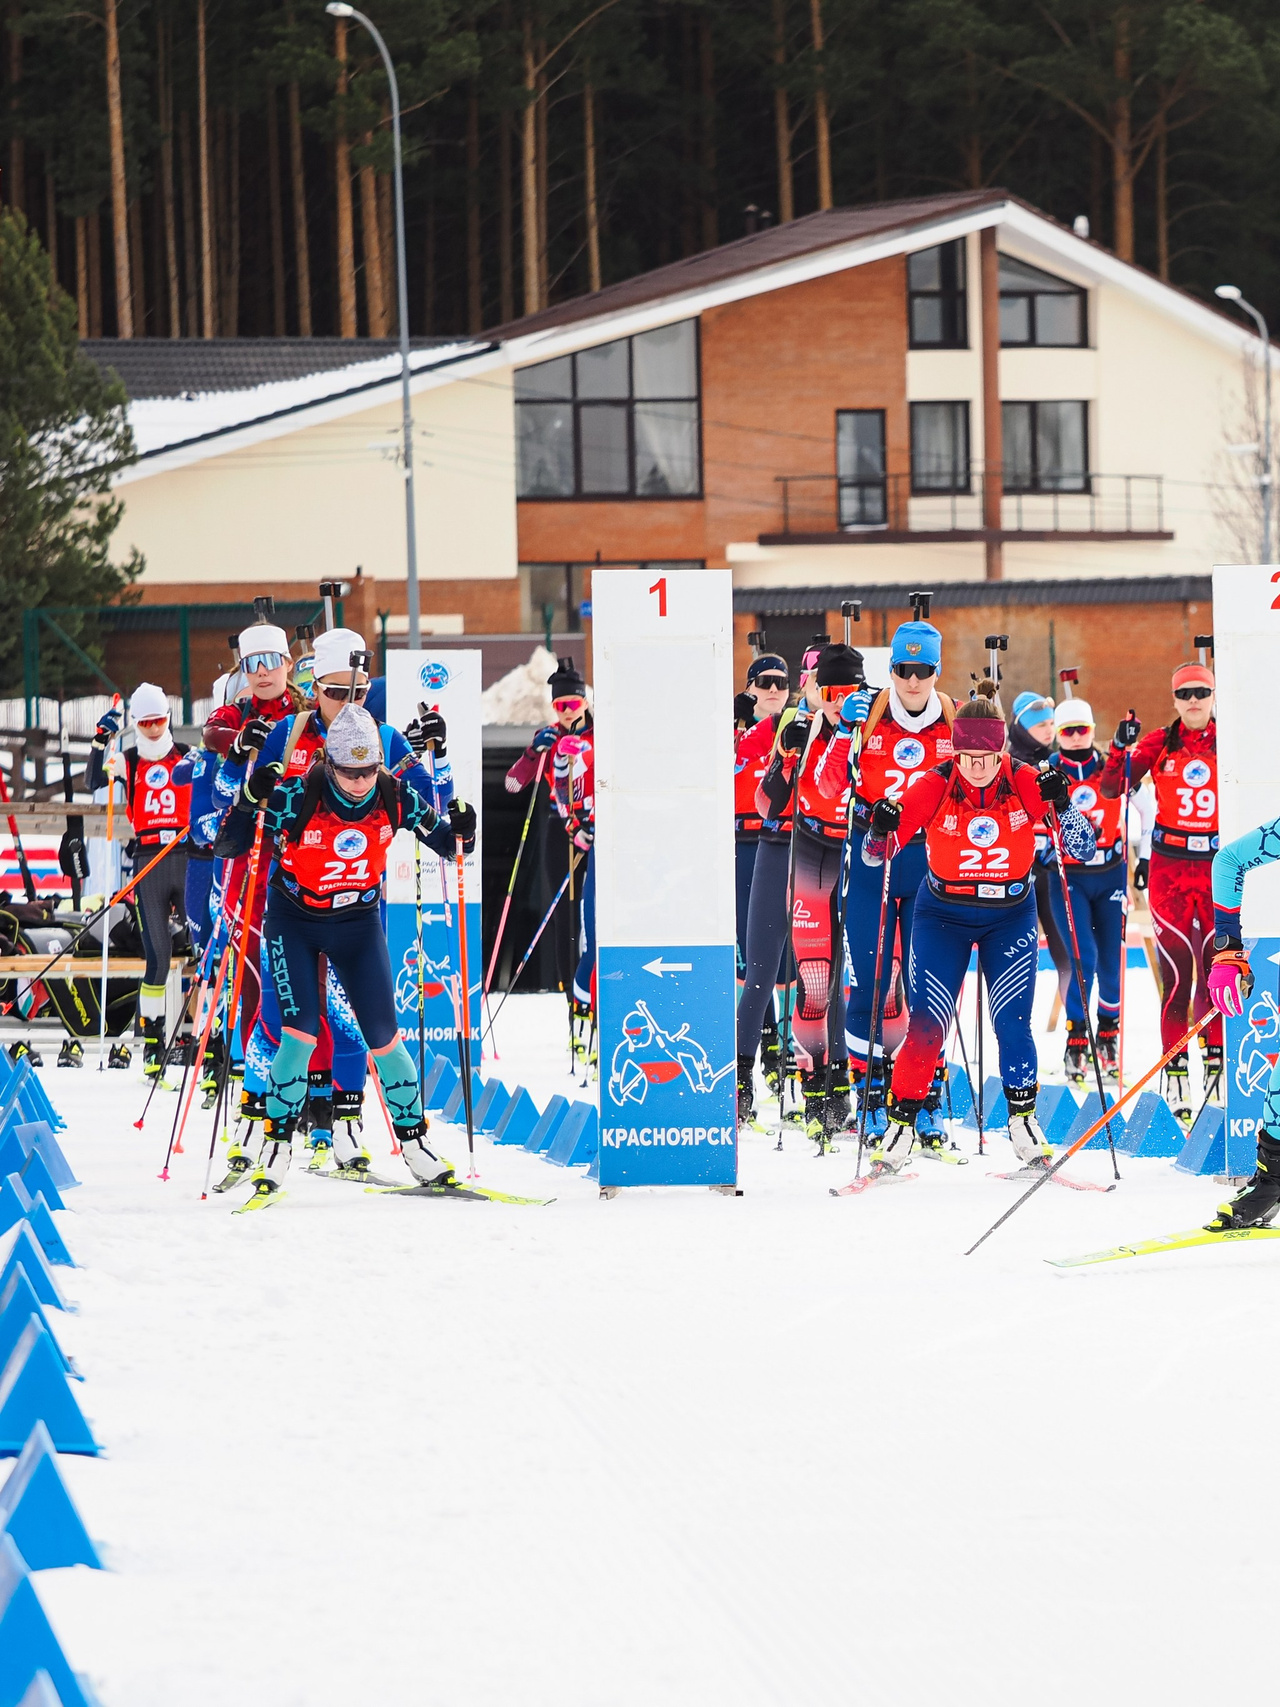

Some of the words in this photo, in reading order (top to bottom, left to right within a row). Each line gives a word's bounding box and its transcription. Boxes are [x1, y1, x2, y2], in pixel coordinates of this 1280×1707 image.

[649, 577, 667, 617] 1
[144, 788, 176, 815] 49
[1175, 788, 1216, 818] 39
[958, 847, 1010, 870] 22
[319, 859, 370, 882] 21
[1003, 926, 1038, 958] MOAX
[345, 1094, 359, 1102] 175
[1015, 1090, 1029, 1098] 172
[406, 1128, 420, 1137] 171
[602, 1127, 734, 1148] КРАСНОЯРСК
[1222, 1231, 1251, 1239] FISCHER
